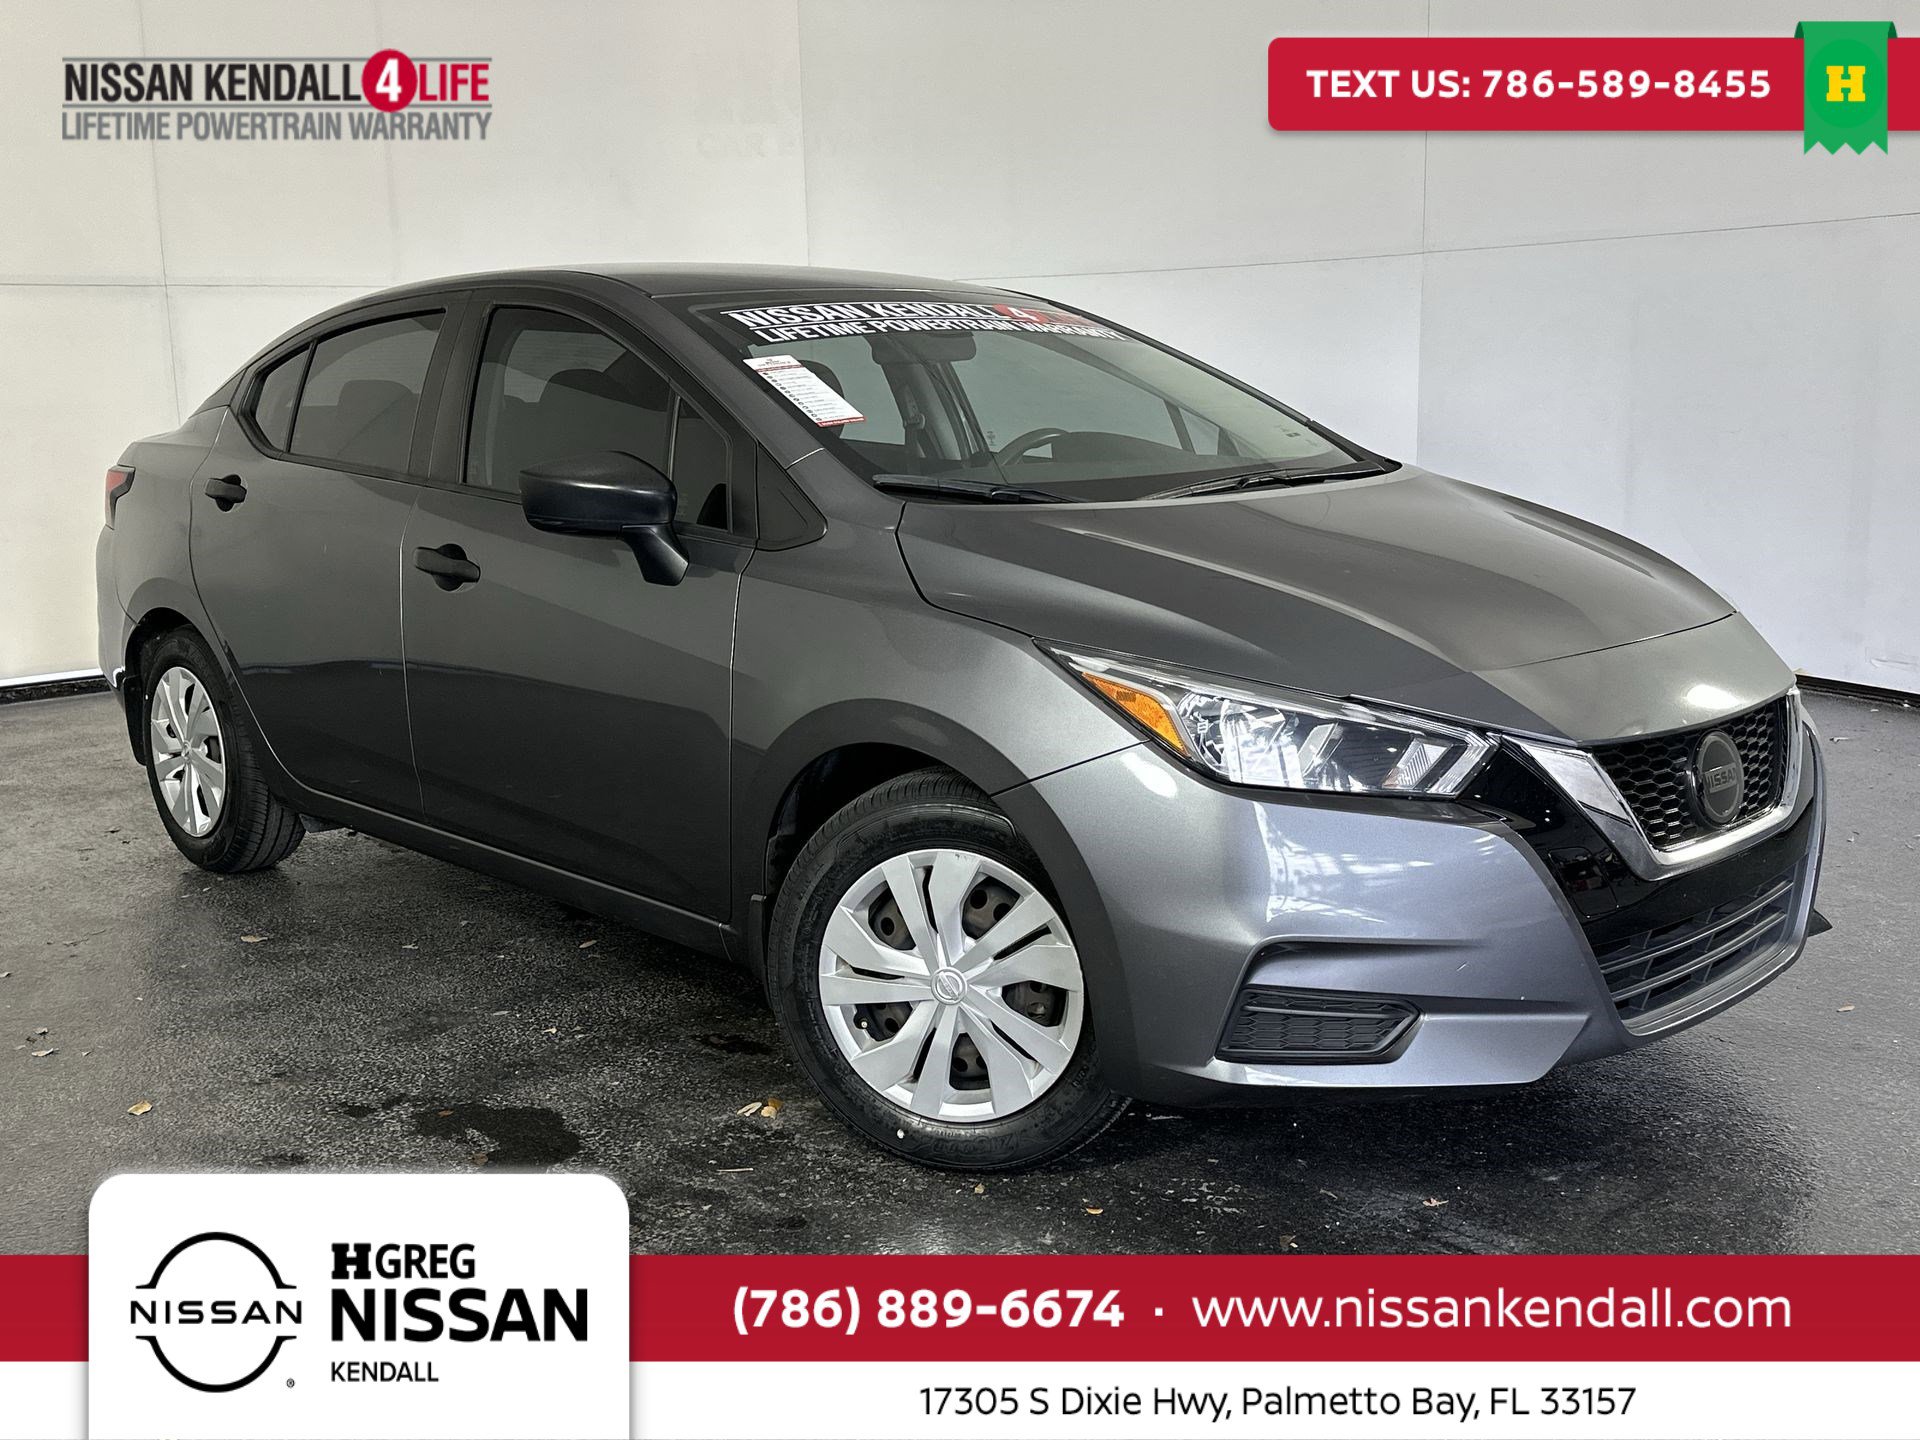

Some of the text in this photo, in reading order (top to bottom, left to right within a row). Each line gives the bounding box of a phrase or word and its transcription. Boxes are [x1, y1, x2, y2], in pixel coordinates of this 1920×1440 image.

[728, 303, 865, 328] NISSAN
[868, 302, 1010, 320] KENDALL
[754, 321, 876, 343] LIFETIME
